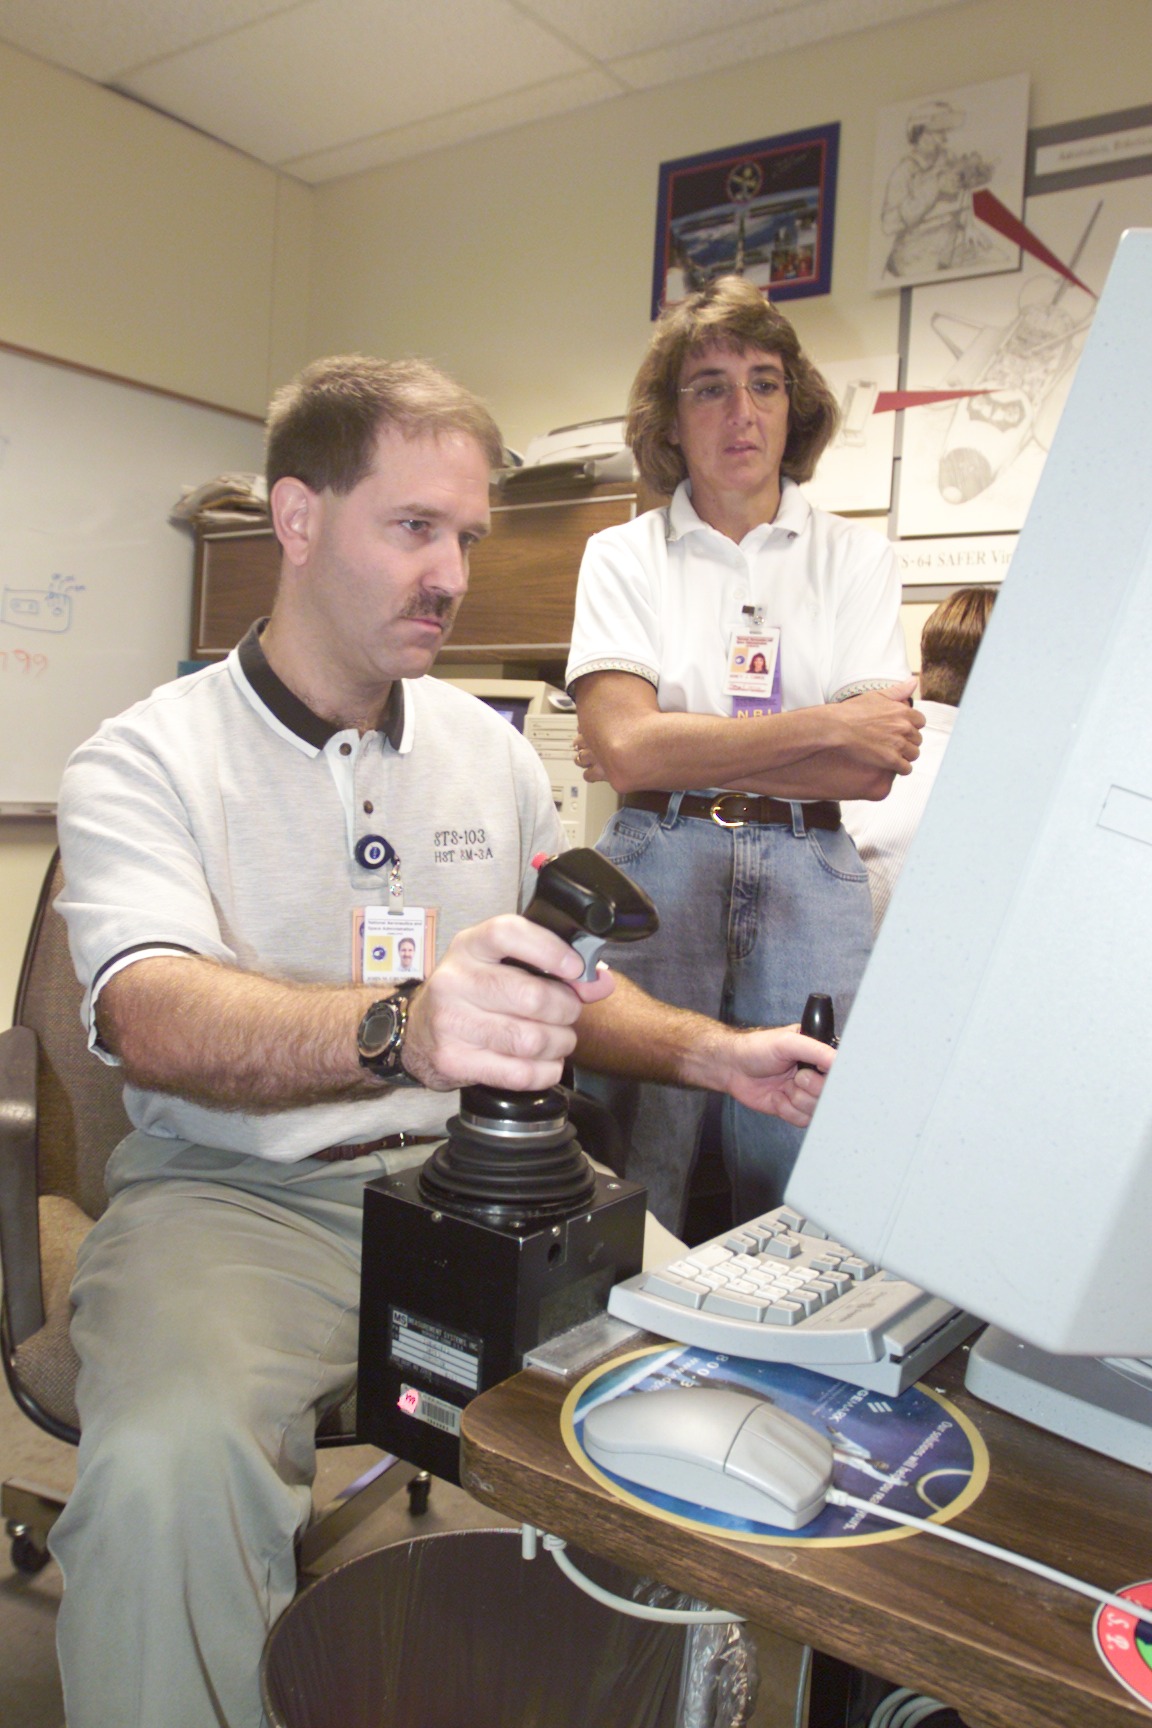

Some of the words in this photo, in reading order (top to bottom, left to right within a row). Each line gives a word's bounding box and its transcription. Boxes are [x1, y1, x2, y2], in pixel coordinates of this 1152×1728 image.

[937, 550, 987, 567] SAFER
[434, 829, 486, 847] STS-103
[434, 851, 456, 863] HST
[937, 1421, 953, 1434] Our
[914, 1431, 941, 1457] solutions
[903, 1455, 918, 1469] will
